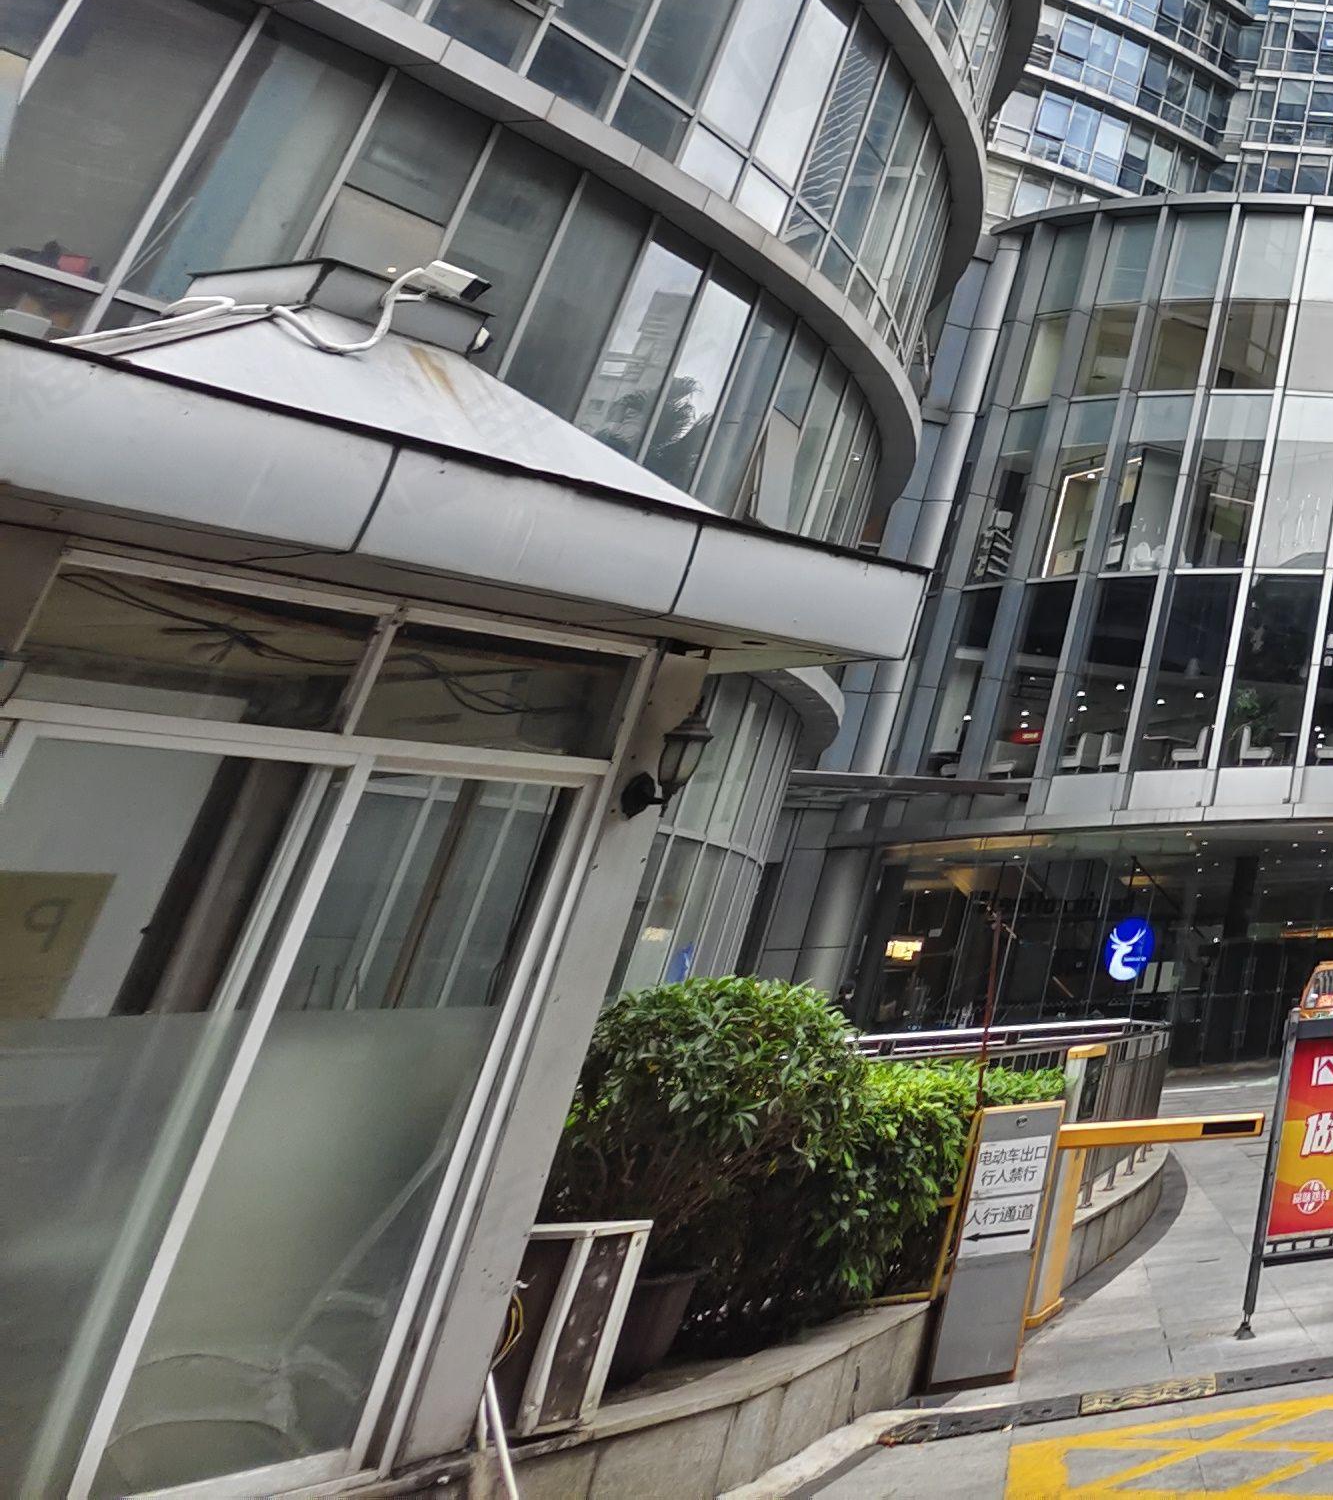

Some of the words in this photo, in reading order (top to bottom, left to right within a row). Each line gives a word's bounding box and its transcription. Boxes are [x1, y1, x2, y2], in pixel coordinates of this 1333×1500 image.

[979, 1144, 1048, 1166] 电动车出口
[981, 1165, 1038, 1187] 行人禁行
[964, 1203, 1035, 1228] 人行通道
